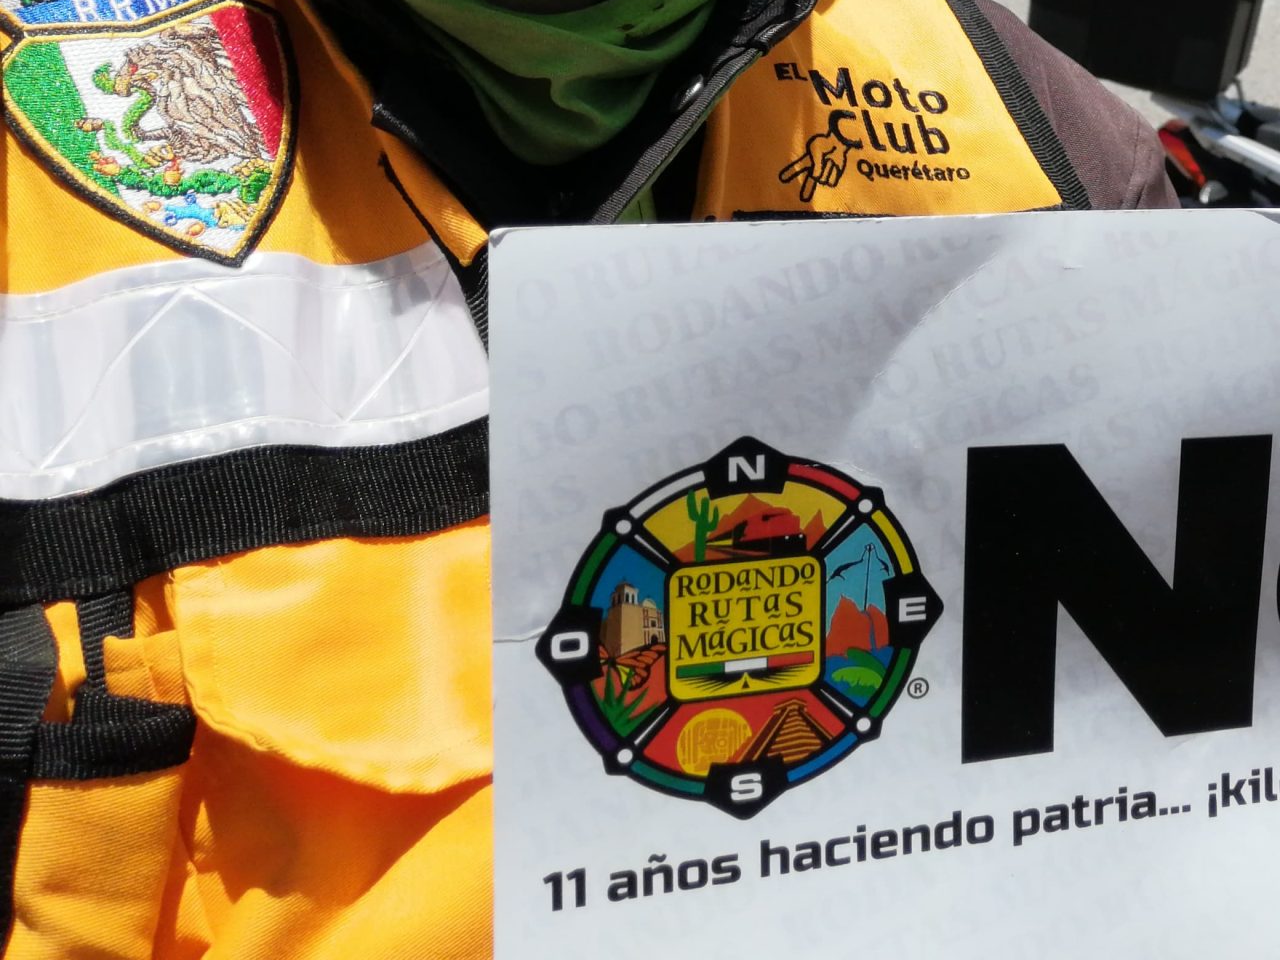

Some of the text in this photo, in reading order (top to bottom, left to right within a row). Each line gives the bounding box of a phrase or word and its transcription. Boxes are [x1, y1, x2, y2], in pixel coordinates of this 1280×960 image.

[774, 62, 949, 115] EL Moto
[828, 109, 951, 156] Club
[856, 160, 971, 182] Querétaro
[728, 454, 766, 482] N
[898, 596, 927, 622] E
[551, 631, 589, 660] O
[730, 772, 763, 801] S
[543, 868, 587, 912] 11
[606, 853, 742, 902] años
[759, 810, 995, 878] haciendo
[1013, 786, 1192, 846] patria...
